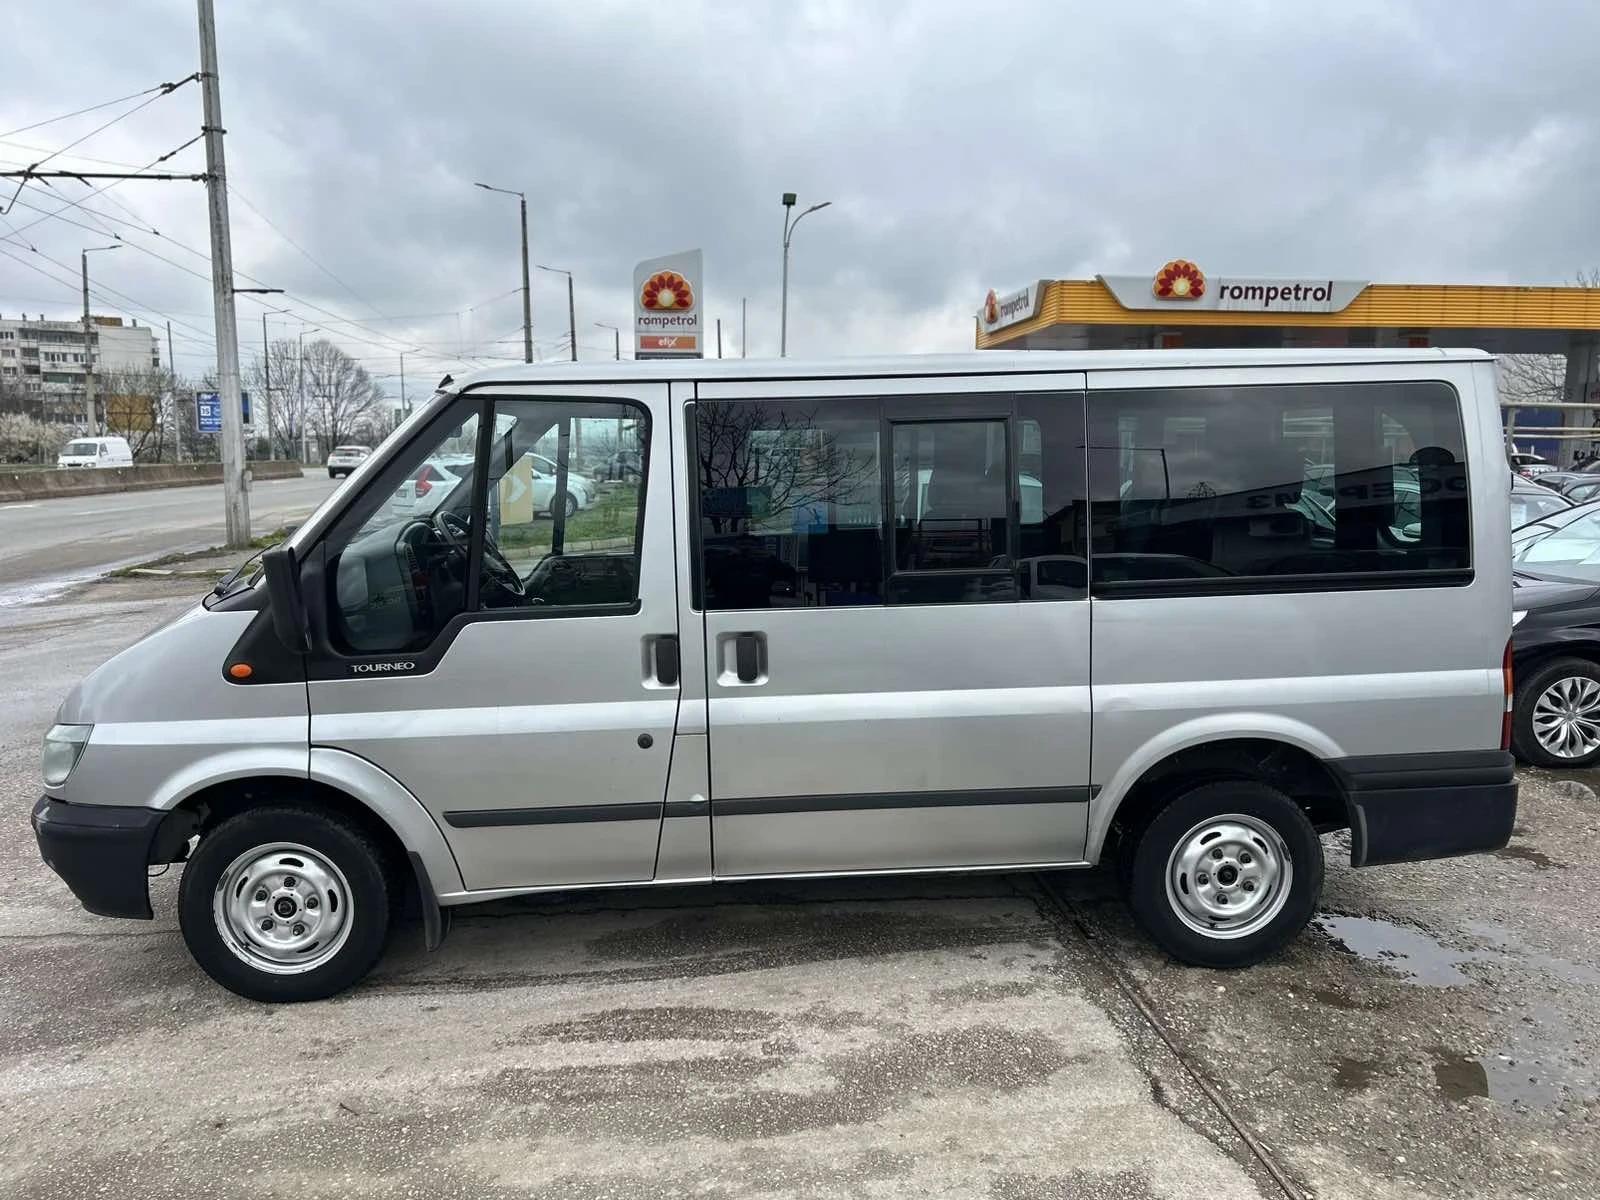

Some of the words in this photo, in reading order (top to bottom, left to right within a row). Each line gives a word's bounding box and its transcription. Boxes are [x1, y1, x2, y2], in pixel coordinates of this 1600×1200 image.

[1000, 287, 1029, 320] rompetrol
[1220, 281, 1333, 307] rompetrol
[638, 314, 697, 328] rompetrol
[350, 661, 416, 673] TOURNEO
